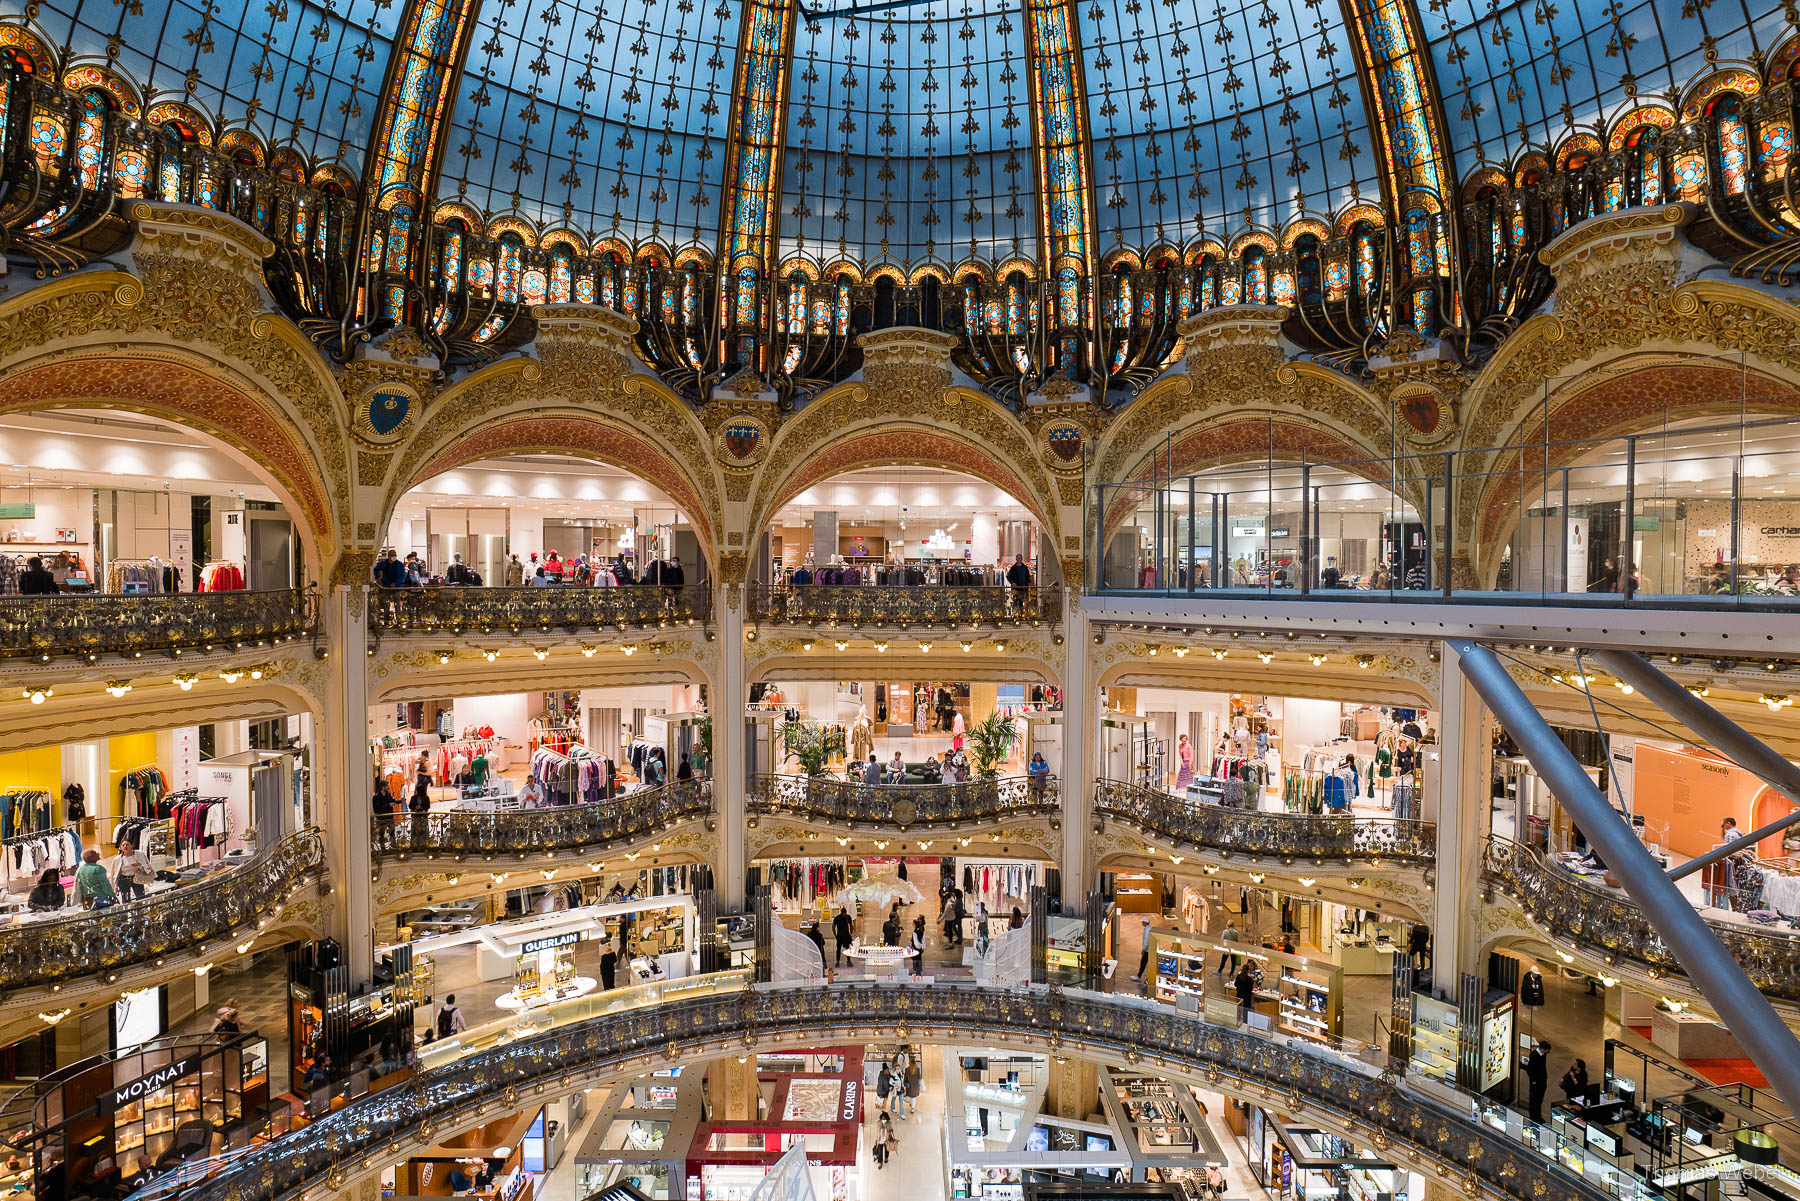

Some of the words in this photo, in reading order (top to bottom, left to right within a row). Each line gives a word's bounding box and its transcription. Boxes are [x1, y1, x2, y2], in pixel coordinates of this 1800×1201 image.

[1702, 763, 1729, 777] seasonly
[525, 934, 578, 952] GUERLAIN
[1497, 1001, 1513, 1014] CHANEL
[117, 1061, 186, 1104] MOYNAT
[144, 1084, 161, 1095] PARIS
[843, 1081, 857, 1120] CLARINS
